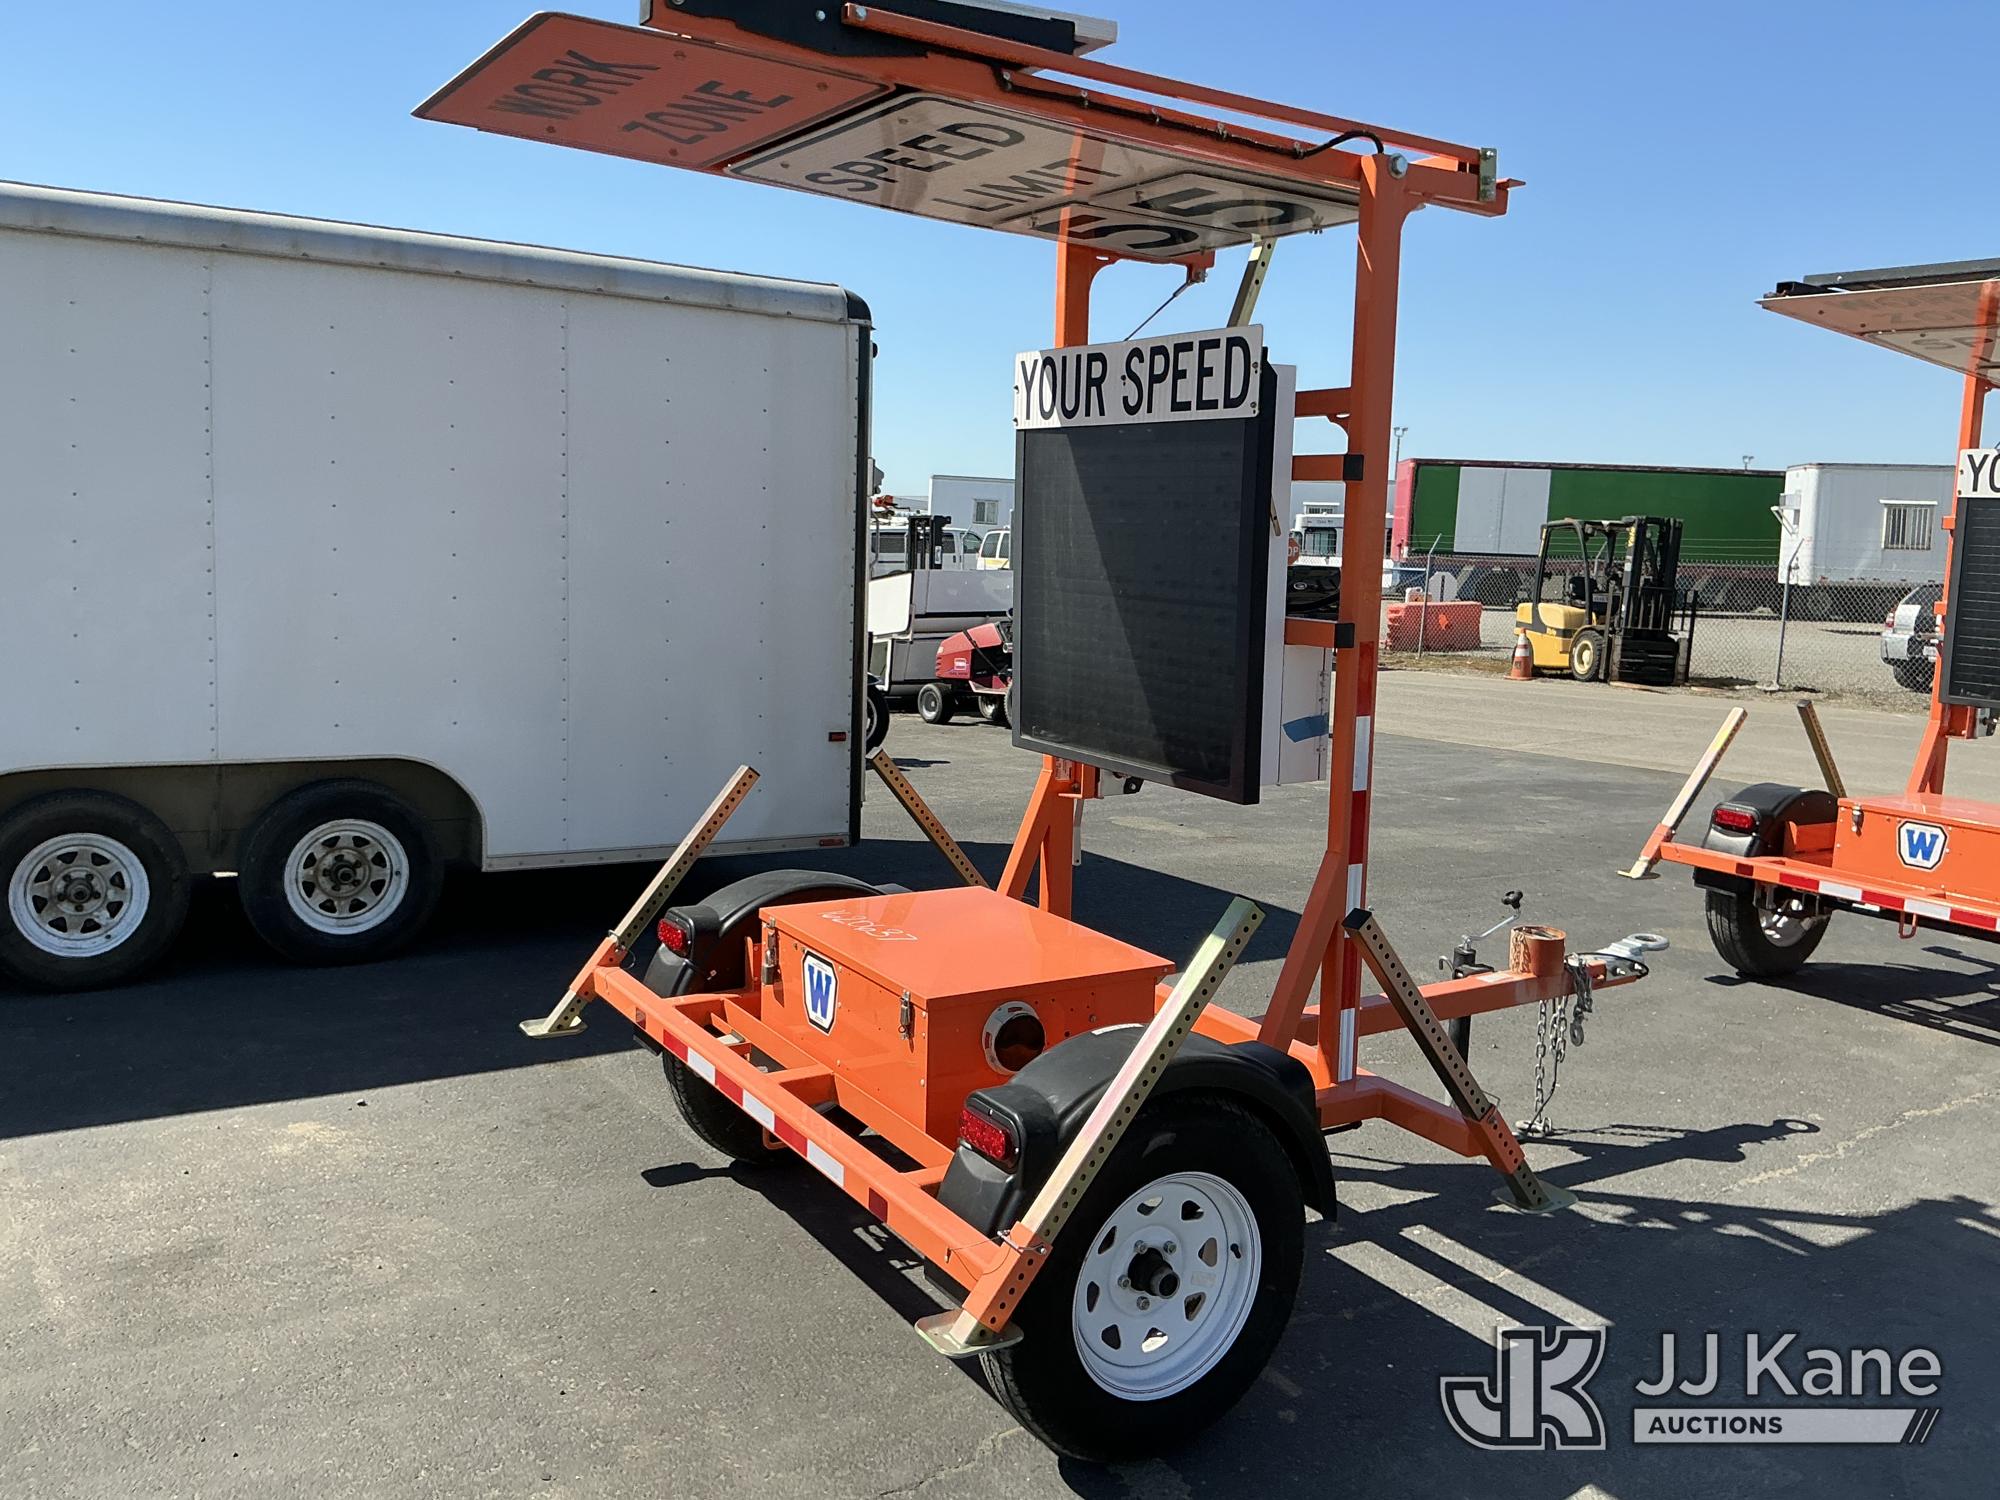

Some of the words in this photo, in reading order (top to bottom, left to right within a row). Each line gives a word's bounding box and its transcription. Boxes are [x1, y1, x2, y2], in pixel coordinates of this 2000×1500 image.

[488, 50, 661, 120] WORK
[621, 80, 794, 145] ZONE
[805, 121, 1025, 193] SPEED
[932, 157, 1121, 213] LIMIT
[1020, 351, 1108, 421] YOUR
[1122, 336, 1251, 415] SPEED
[1905, 829, 1939, 862] W
[808, 963, 832, 1020] W
